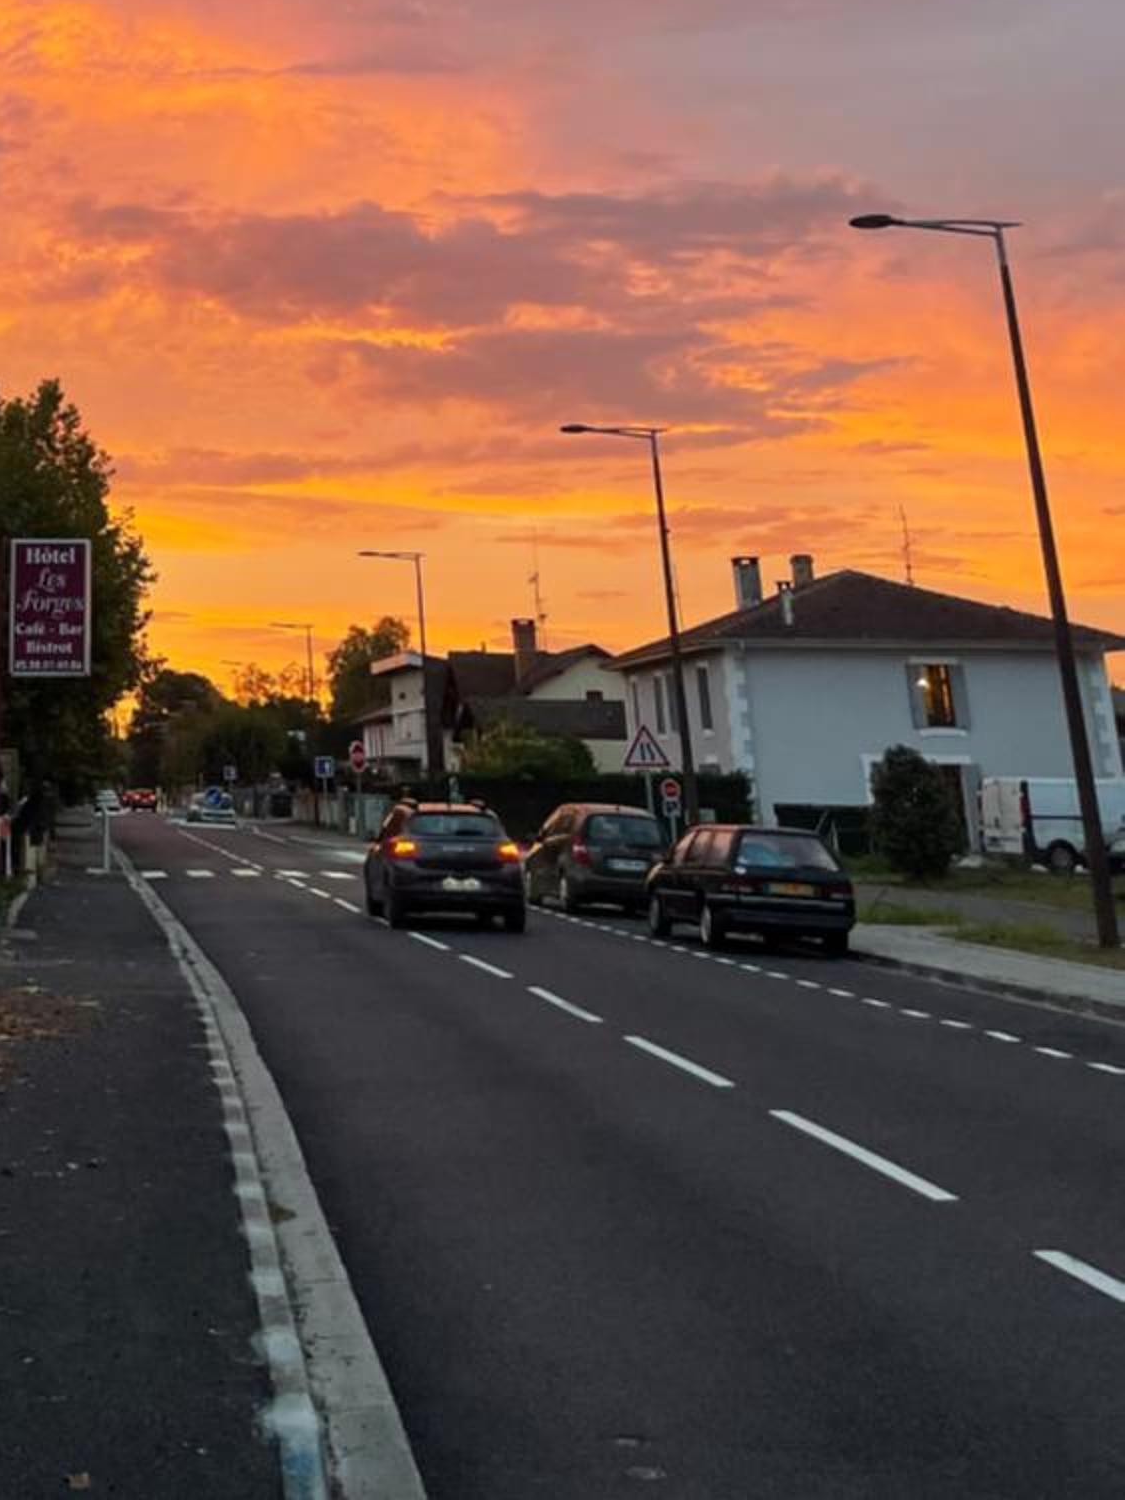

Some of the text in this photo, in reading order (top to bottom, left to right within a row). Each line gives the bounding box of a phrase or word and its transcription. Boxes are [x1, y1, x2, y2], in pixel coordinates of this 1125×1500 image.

[26, 546, 75, 564] Hôtel
[16, 621, 45, 635] Café
[59, 622, 82, 635] Bar
[26, 640, 73, 653] Bistrot
